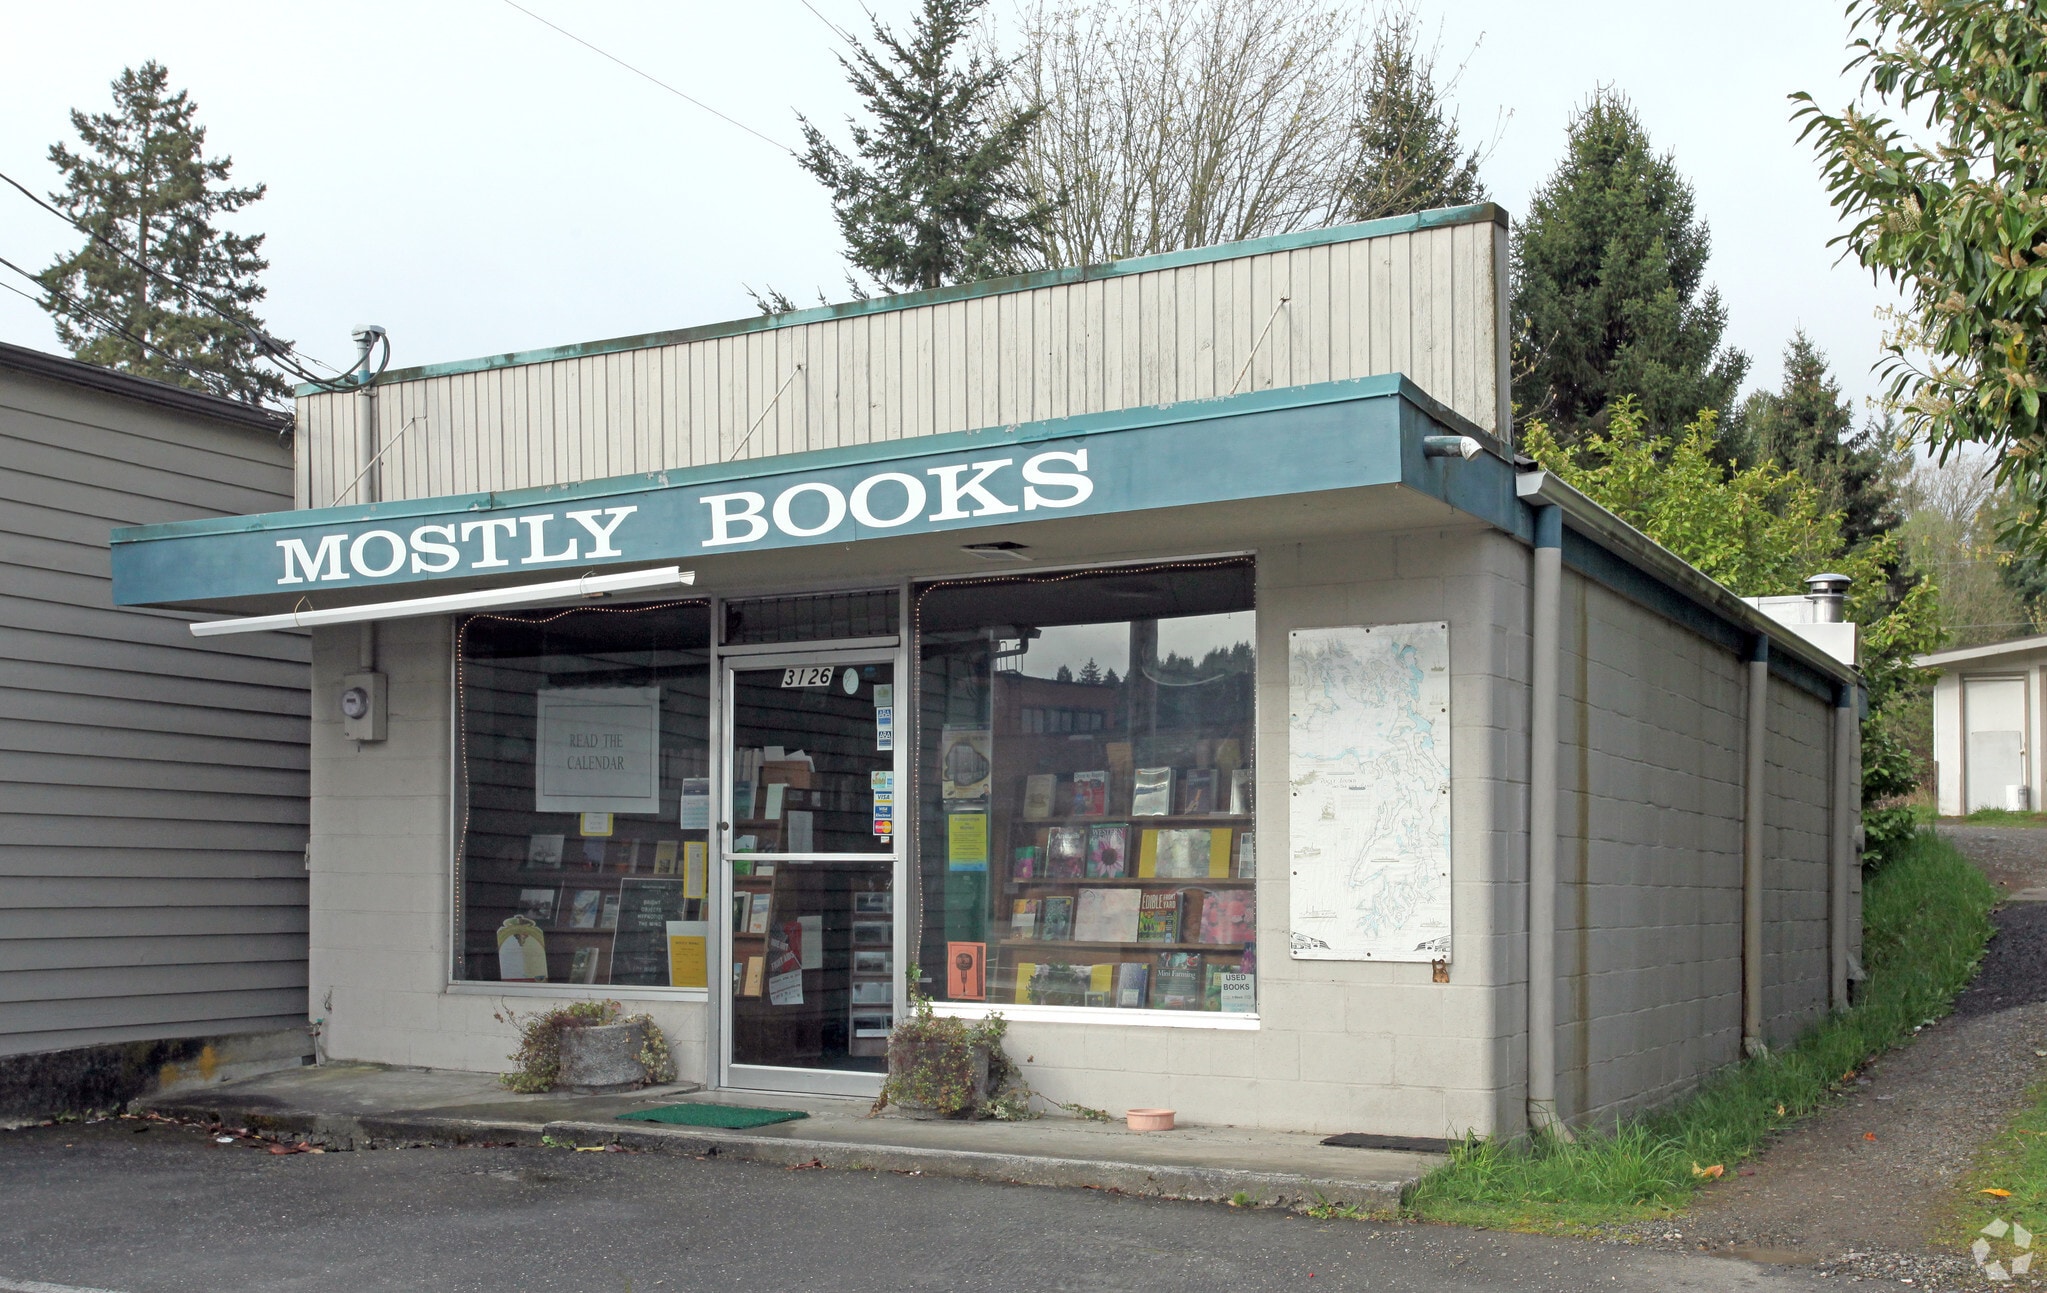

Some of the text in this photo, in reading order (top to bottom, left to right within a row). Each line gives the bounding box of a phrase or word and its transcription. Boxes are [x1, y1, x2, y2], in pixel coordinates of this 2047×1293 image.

[276, 448, 1094, 585] MOSTLY BOOKS
[785, 667, 831, 686] 3126
[569, 733, 624, 748] READ THE
[567, 755, 624, 770] CALENDAR
[1141, 893, 1163, 910] EDIBLE
[1163, 900, 1177, 909] YARD
[1157, 969, 1196, 980] Mini Farming
[1225, 973, 1246, 981] USED
[1223, 983, 1250, 991] BOOKS
